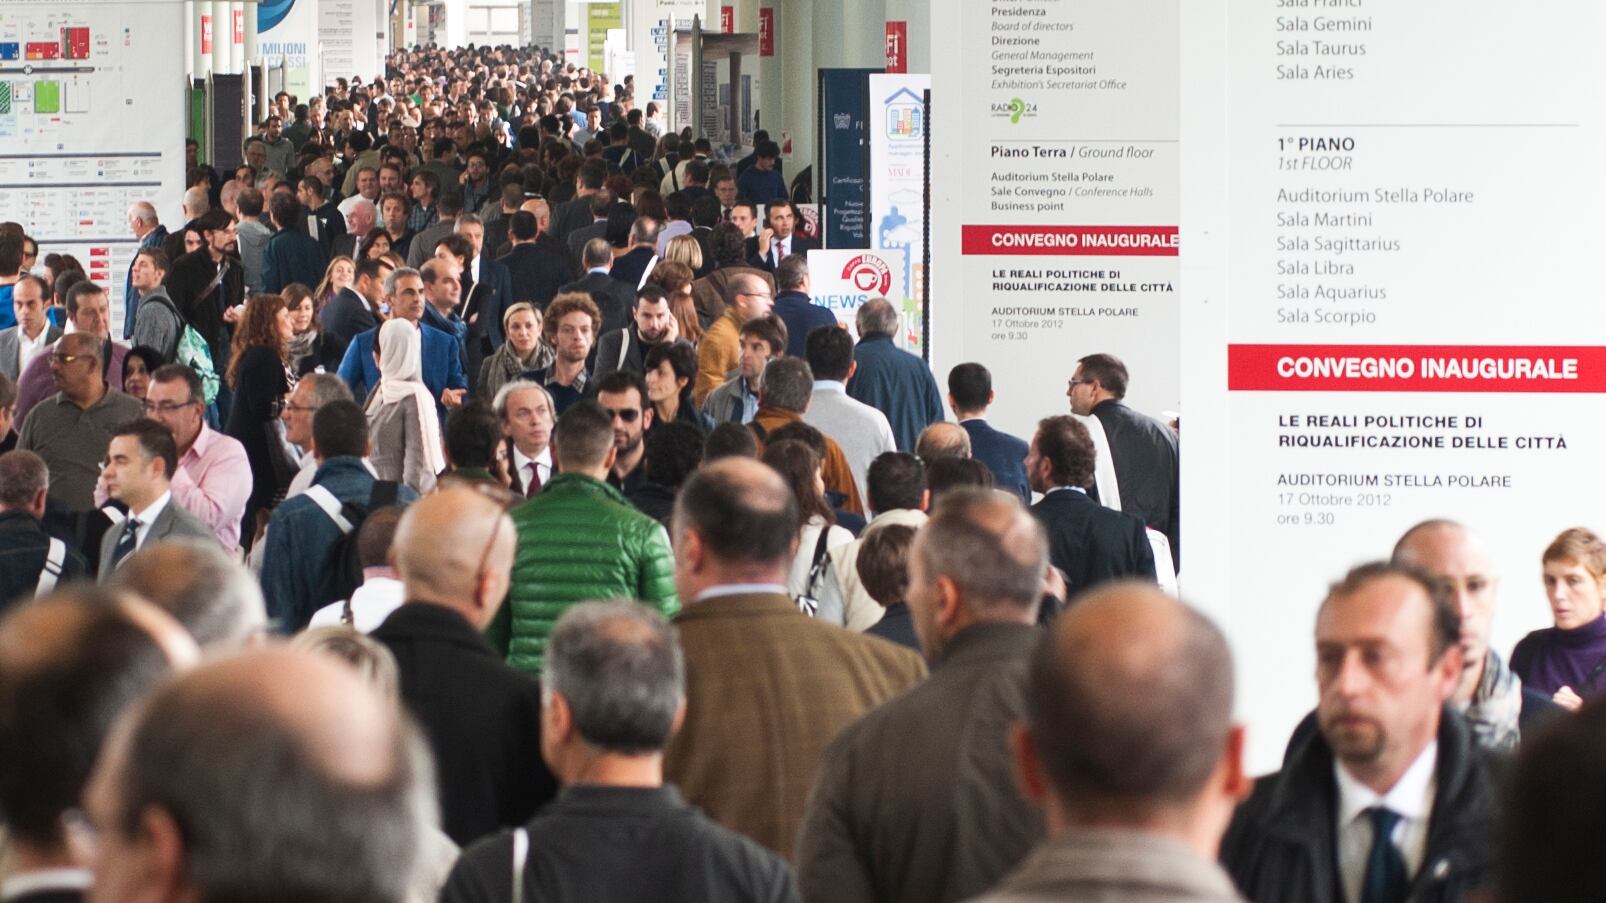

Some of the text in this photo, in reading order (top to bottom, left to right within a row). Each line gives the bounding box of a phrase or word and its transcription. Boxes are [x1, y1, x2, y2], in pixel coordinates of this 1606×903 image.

[991, 7, 1047, 17] Presidenza
[991, 21, 1021, 32] Board
[1032, 21, 1074, 32] directors
[1276, 16, 1372, 32] Sala Gemini
[991, 36, 1040, 46] Direzione
[1276, 40, 1367, 56] Sala Taurus
[991, 50, 1094, 63] General Management
[991, 65, 1096, 77] Segreteria Espositori
[1276, 64, 1354, 80] Sala Aries
[1046, 80, 1098, 90] Secretariat
[1098, 80, 1127, 90] Office
[1026, 103, 1037, 112] 24
[1298, 138, 1355, 152] PIANO
[991, 146, 1030, 158] Piano
[1032, 146, 1067, 158] Terra
[1078, 146, 1125, 159] Ground
[1126, 146, 1155, 159] floor
[1278, 156, 1353, 171] 1st FLOOR
[990, 172, 1114, 182] Auditorium Stella Polare
[991, 187, 1013, 197] Sale
[1014, 187, 1066, 199] Convegno
[1074, 187, 1129, 198] Conference
[1129, 187, 1153, 197] Halls
[1276, 188, 1474, 203] Auditorium Stella Polare
[991, 201, 1064, 213] Business point
[1276, 211, 1372, 227] Sala Martini
[991, 233, 1179, 248] CONVEGNO INAUGURALE
[1276, 236, 1401, 254] Sala Sagittarius
[992, 270, 1121, 279] LE REALI POLITICHE DI
[1276, 260, 1354, 276] Sala Libra
[992, 282, 1174, 293] RIQUALIFICAZIONE DELLE CITTÀ
[1276, 284, 1387, 303] Sala Aquarius
[991, 307, 1138, 317] AUDITORIUM STELLA POLARE
[1277, 308, 1376, 327] Sala Scorpio
[992, 319, 1064, 329] 17 Ottobre 2012
[991, 332, 1028, 341] ore 9.30
[1276, 357, 1579, 380] CONVEGNO INAUGURALE
[1278, 415, 1482, 429] LE REALI POLITICHE DI
[1278, 434, 1567, 449] RIQUALIFICAZIONE DELLE CITTÀ
[1277, 474, 1511, 488] AUDITORIUM STELLA POLARE
[1278, 493, 1392, 507] 17 Ottobre 2012
[1276, 512, 1335, 525] ore 9.30
